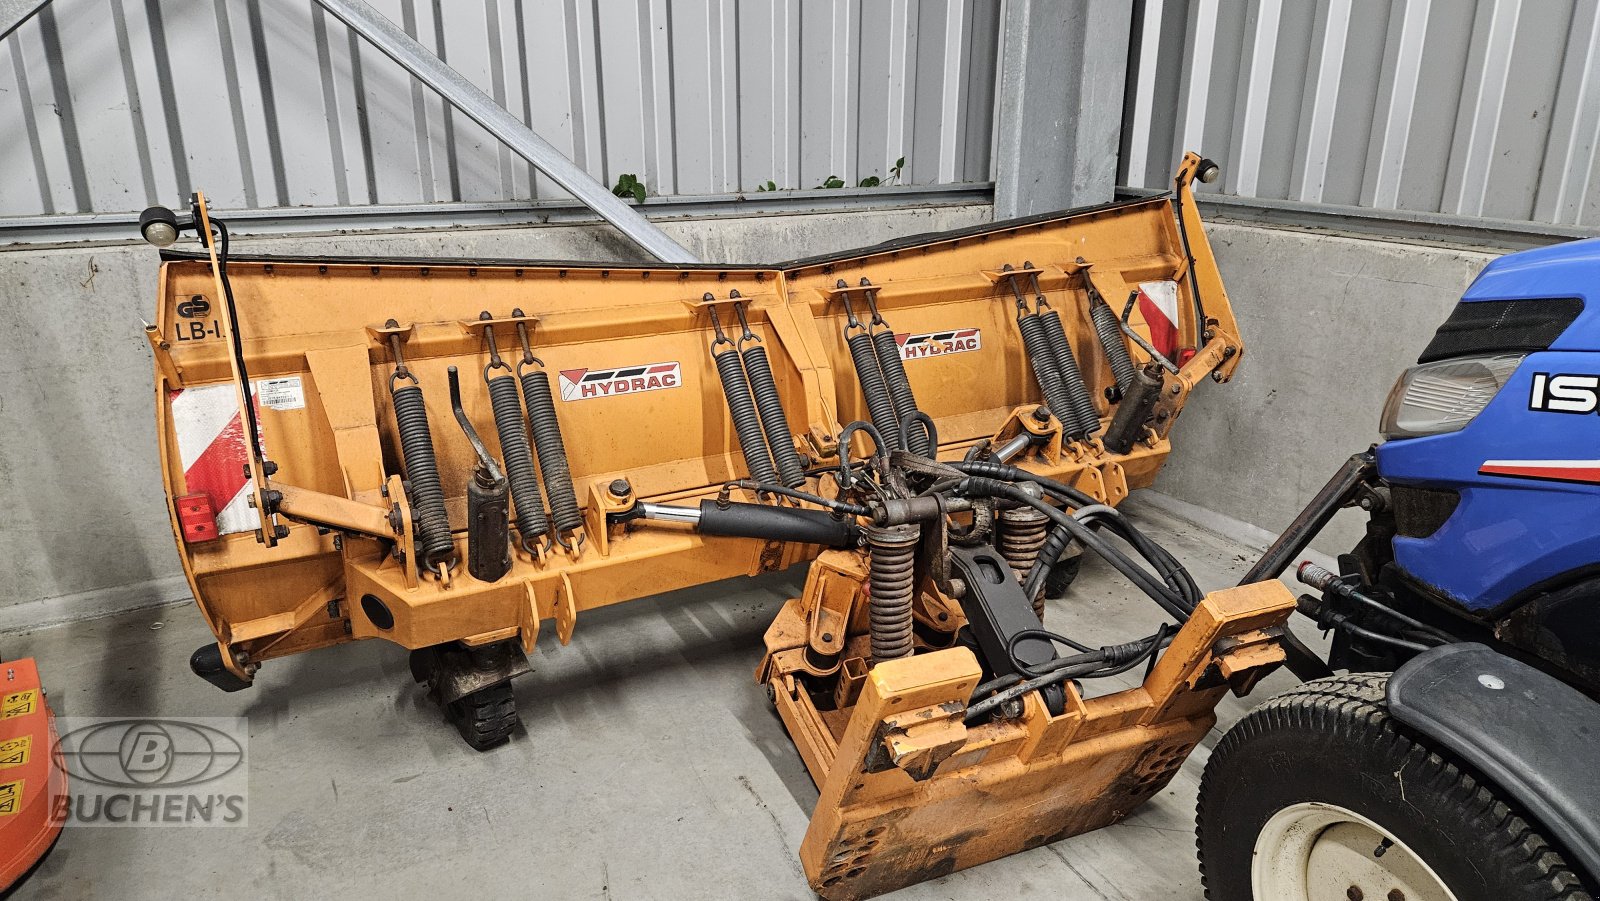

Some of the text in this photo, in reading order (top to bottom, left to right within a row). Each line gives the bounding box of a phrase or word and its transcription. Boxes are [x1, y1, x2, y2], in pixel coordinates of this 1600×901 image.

[175, 319, 227, 341] LB-I
[581, 374, 676, 397] HYDRAC
[1528, 372, 1600, 415] IS
